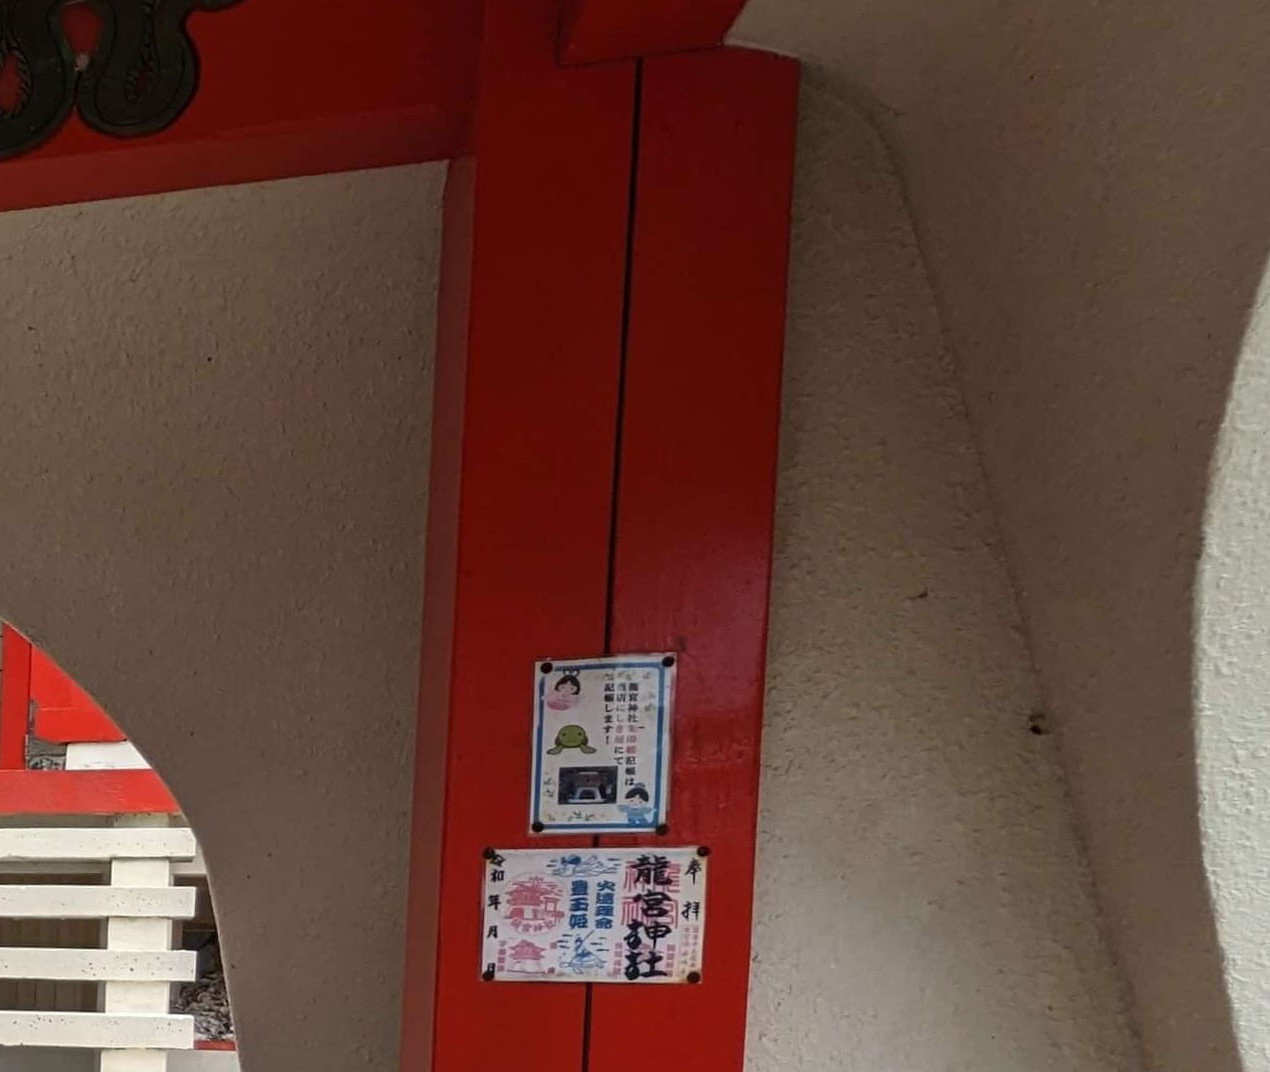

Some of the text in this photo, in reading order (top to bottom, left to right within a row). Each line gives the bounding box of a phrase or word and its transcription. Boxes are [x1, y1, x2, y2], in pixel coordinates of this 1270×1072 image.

[490, 854, 506, 883] 令和
[488, 894, 501, 910] 年
[624, 855, 672, 981] 龍宮神社
[487, 925, 498, 939] 月
